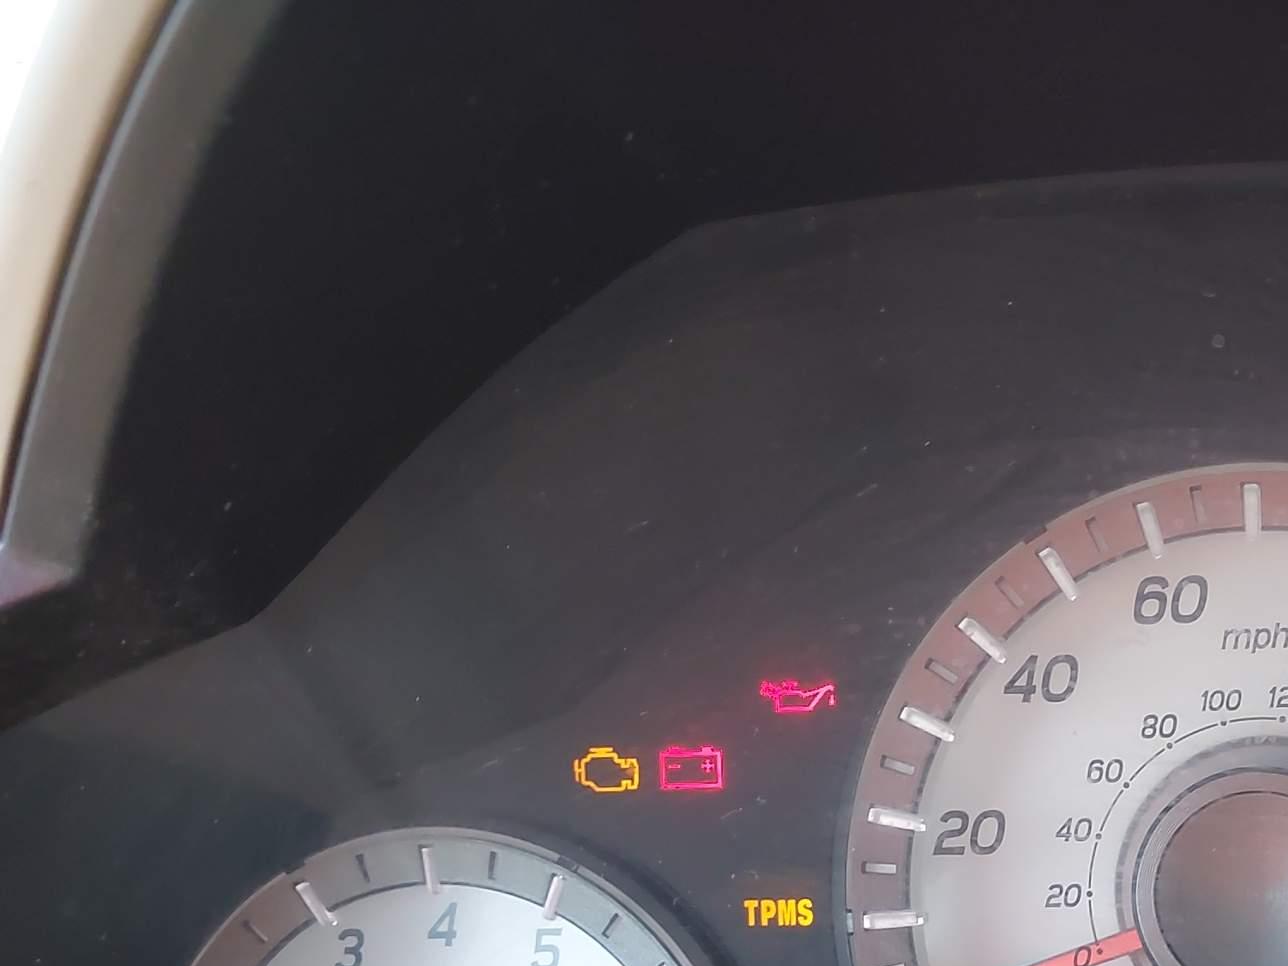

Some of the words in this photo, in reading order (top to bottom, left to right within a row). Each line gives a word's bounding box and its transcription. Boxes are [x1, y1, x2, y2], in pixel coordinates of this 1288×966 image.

[1133, 574, 1209, 626] 60
[1003, 653, 1080, 705] 40
[1199, 688, 1243, 713] 100
[1141, 714, 1178, 740] 80
[1086, 758, 1124, 784] 60
[933, 810, 1007, 856] 20
[1055, 817, 1092, 844] 40
[1045, 883, 1082, 909] 20
[427, 903, 457, 947] 4
[743, 898, 814, 927] TPMS
